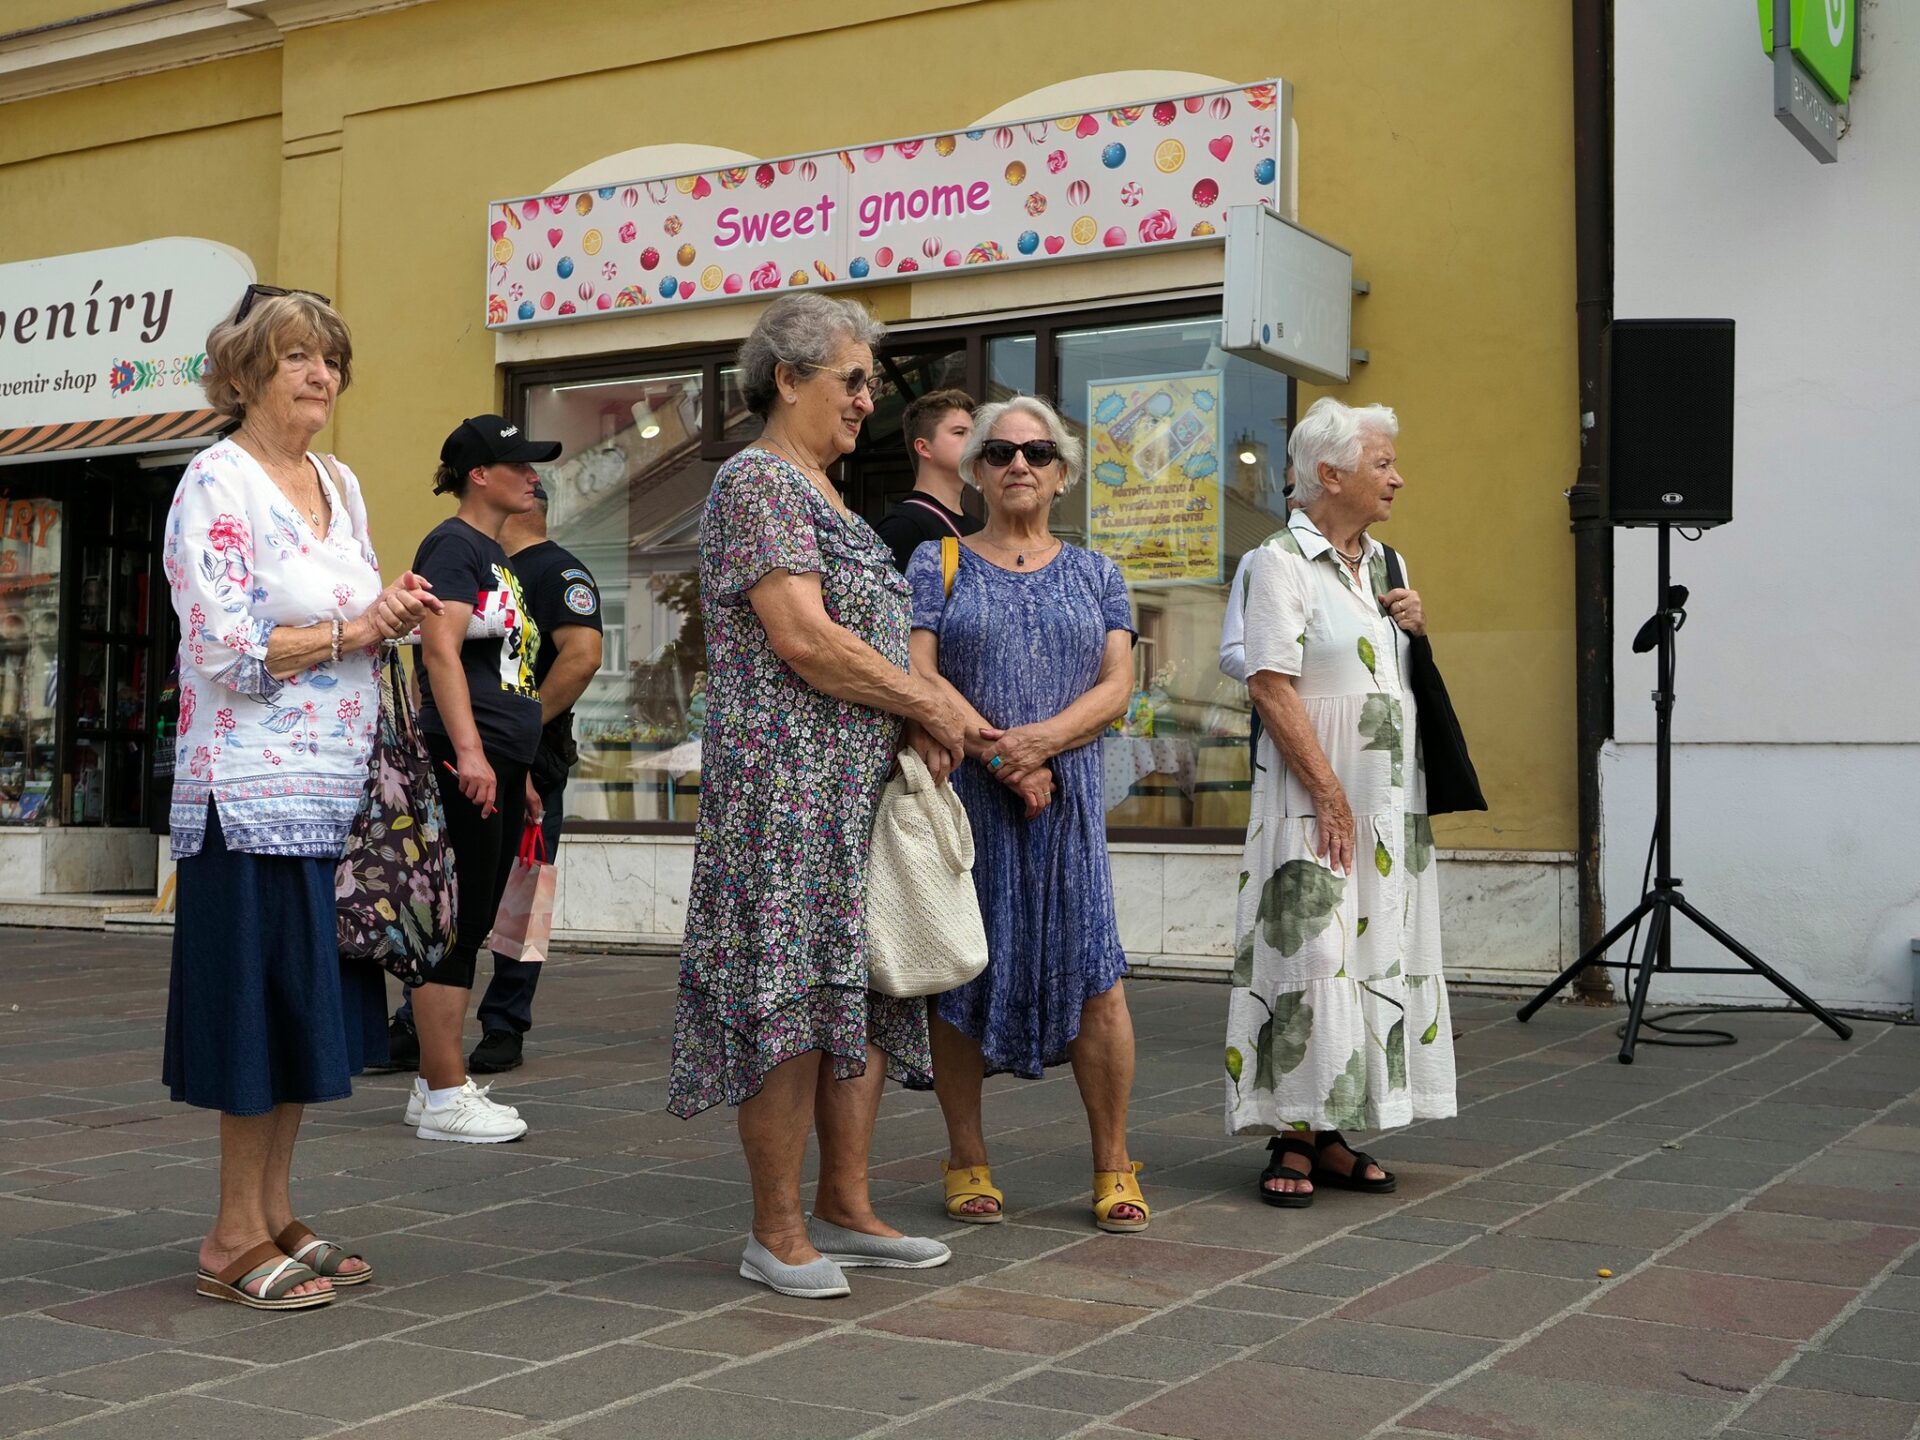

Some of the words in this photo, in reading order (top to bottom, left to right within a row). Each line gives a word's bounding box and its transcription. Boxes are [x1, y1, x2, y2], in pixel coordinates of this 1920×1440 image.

[713, 194, 836, 248] Sweet
[858, 180, 991, 238] gnome
[0, 279, 174, 344] eníry
[0, 373, 49, 397] venir
[53, 369, 97, 394] shop
